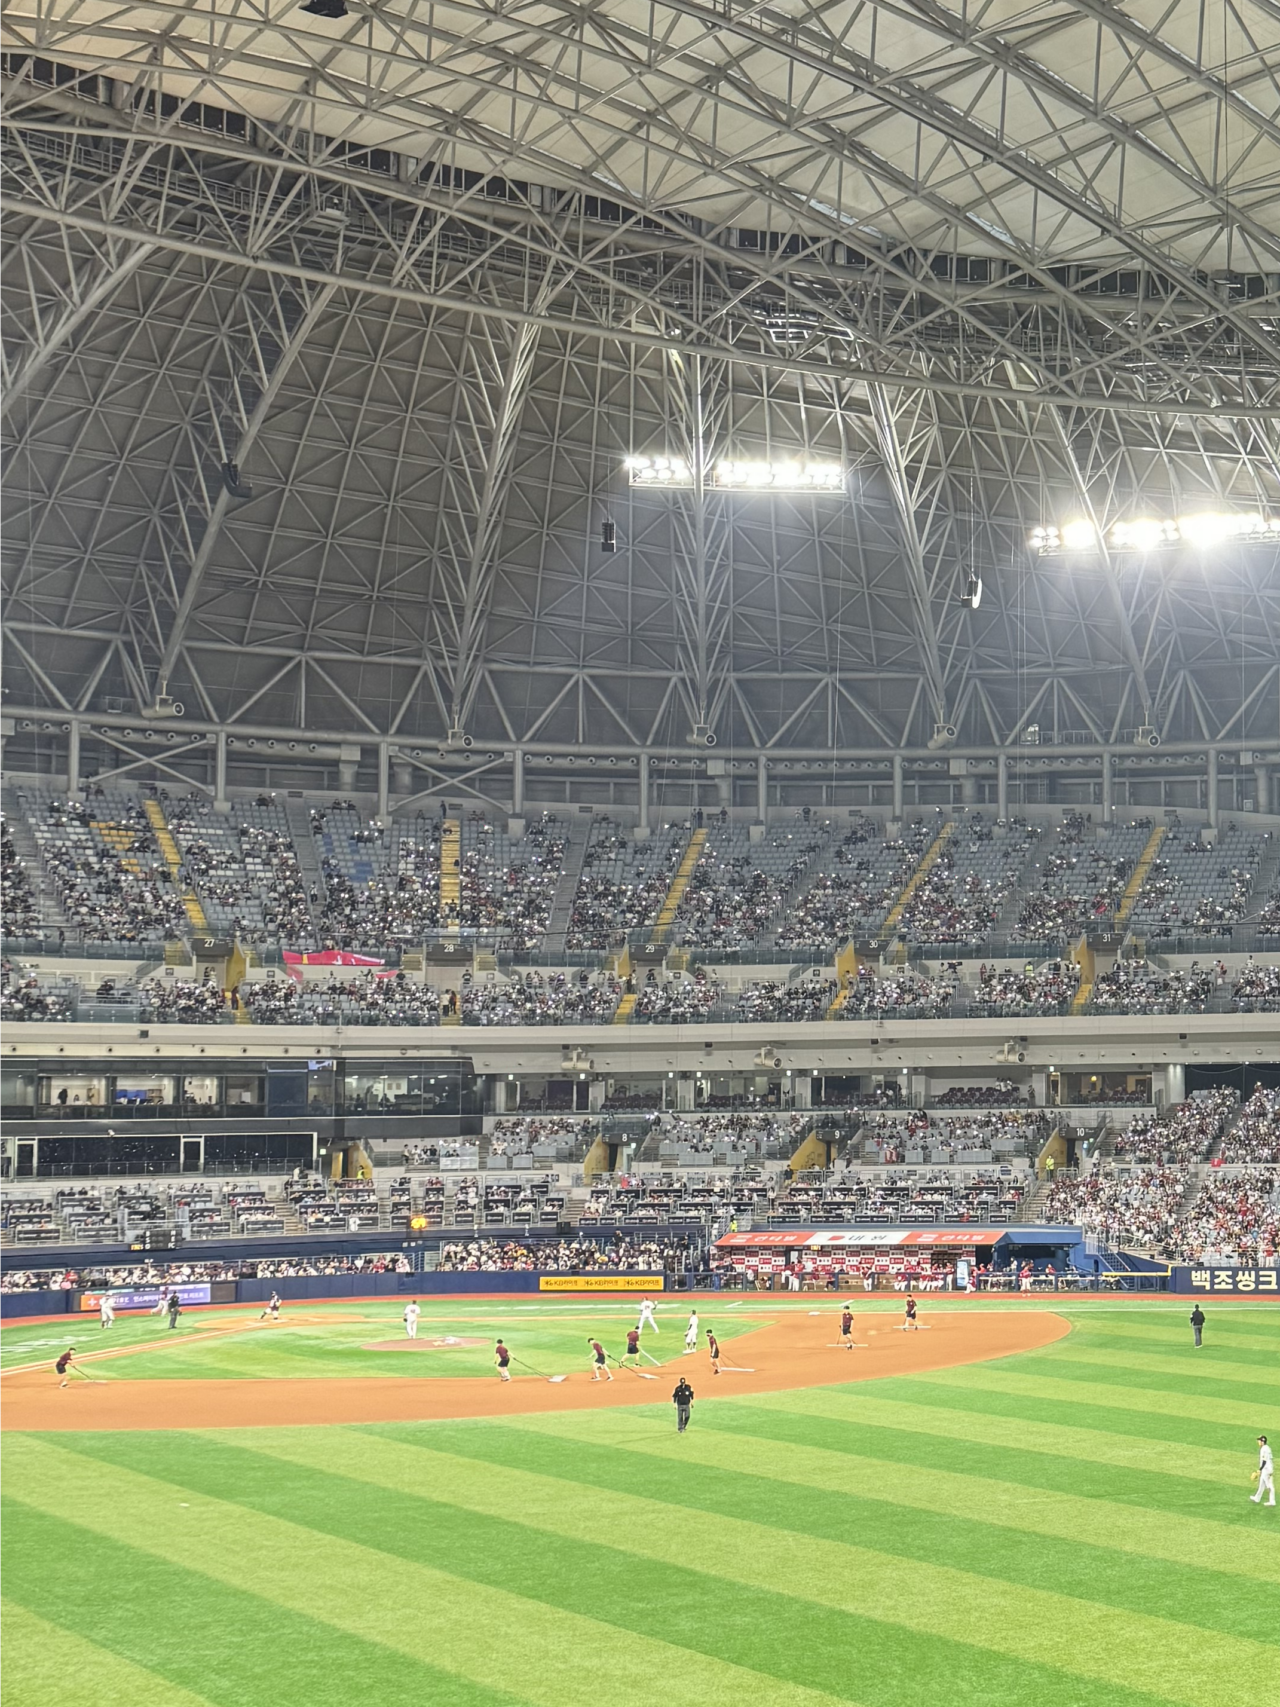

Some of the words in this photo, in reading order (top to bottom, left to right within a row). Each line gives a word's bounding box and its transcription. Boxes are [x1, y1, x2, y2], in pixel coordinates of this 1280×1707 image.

[1102, 933, 1111, 942] 31
[204, 939, 215, 947] 27
[869, 940, 878, 948] 30
[444, 944, 454, 952] 28
[645, 944, 655, 952] 29
[834, 1130, 840, 1139] 9
[1076, 1127, 1085, 1136] 10
[622, 1133, 628, 1142] 8
[1190, 1269, 1278, 1291] 백조씽크
